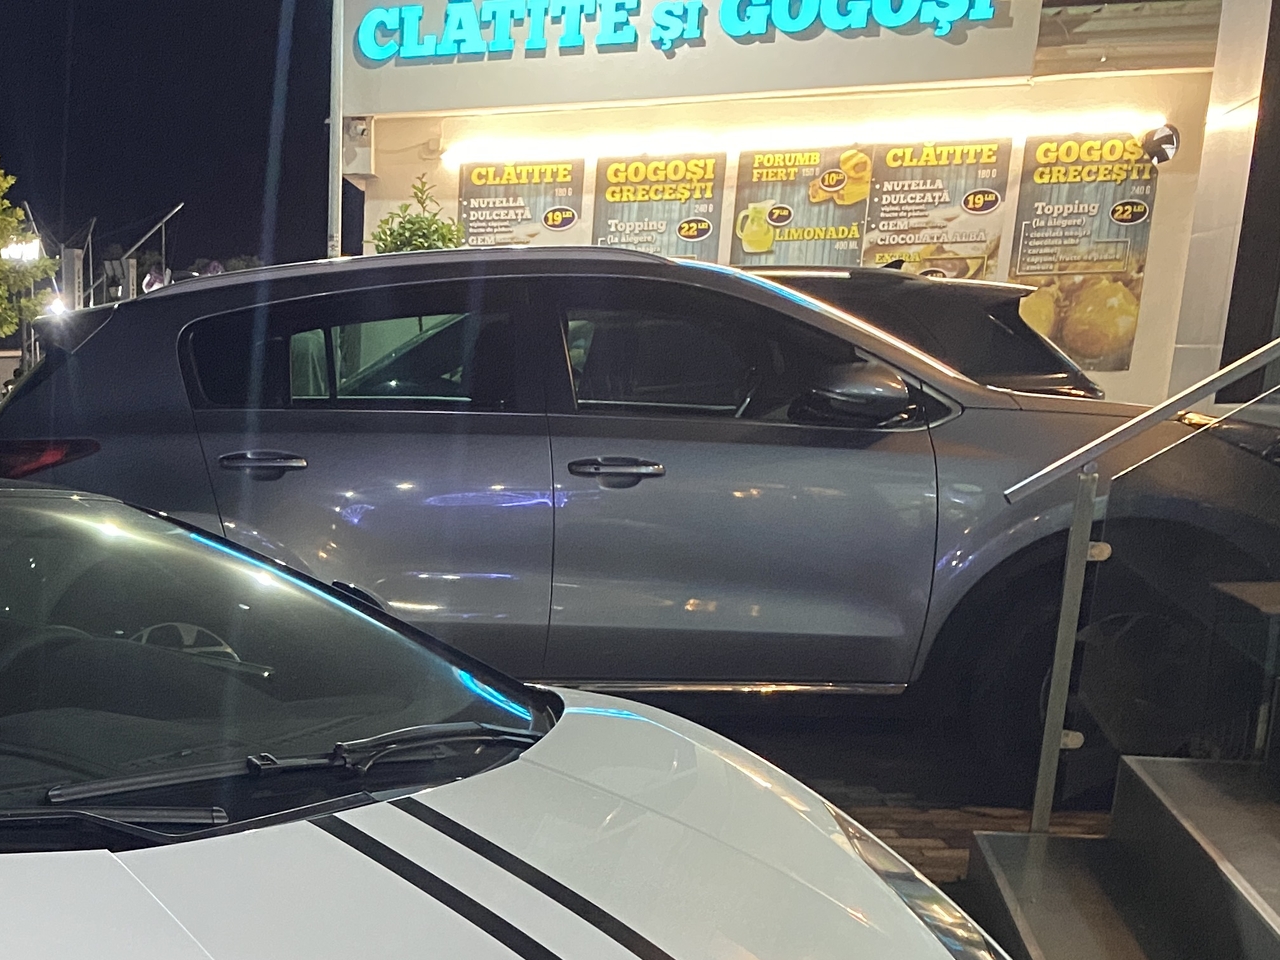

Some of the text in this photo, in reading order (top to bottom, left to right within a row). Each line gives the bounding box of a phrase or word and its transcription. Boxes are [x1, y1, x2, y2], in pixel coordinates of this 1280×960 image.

[753, 152, 820, 167] PORUMB
[752, 168, 798, 182] FIERT
[883, 180, 943, 191] NUTELLA
[1130, 185, 1150, 195] 240 G
[470, 197, 525, 208] NUTELLA
[1034, 200, 1099, 217] Topping
[607, 218, 667, 233] Topping
[775, 222, 860, 240] LIMONADĂ
[879, 221, 908, 231] GEM
[469, 236, 495, 245] GEM
[849, 241, 858, 249] ML
